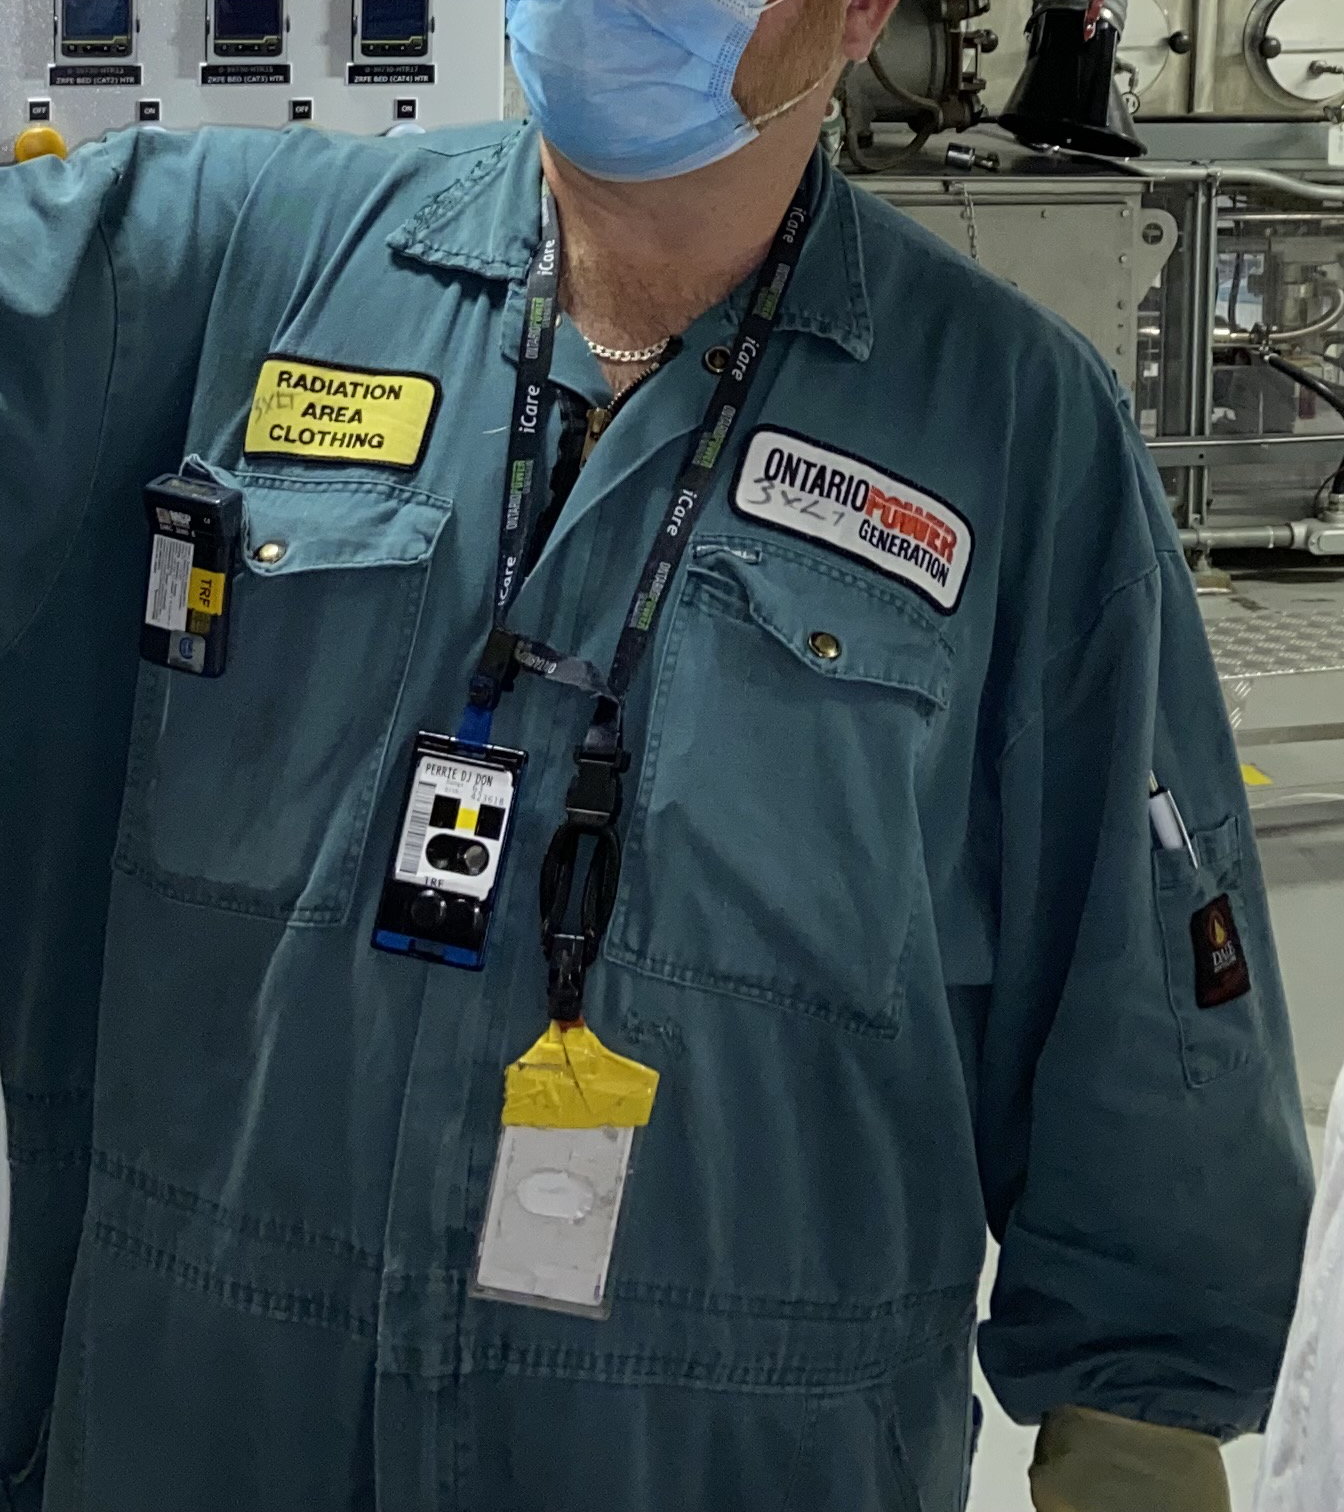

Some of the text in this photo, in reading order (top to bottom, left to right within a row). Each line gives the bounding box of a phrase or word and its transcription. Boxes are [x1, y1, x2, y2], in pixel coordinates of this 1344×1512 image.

[76, 76, 92, 84] BED
[120, 76, 135, 84] HTR
[226, 75, 242, 83] BED
[269, 75, 284, 83] HTR
[373, 75, 388, 83] BED
[32, 107, 46, 115] OFF
[783, 206, 805, 244] iCare
[537, 239, 556, 276] iCare
[732, 335, 756, 382] iCare
[277, 370, 403, 400] RADIATION
[301, 402, 363, 424] AREA
[519, 384, 540, 434] iCare
[269, 424, 385, 449] CLOTHING
[667, 488, 698, 537] iCare
[858, 518, 950, 588] GENERATION
[199, 578, 213, 607] TRF
[498, 556, 517, 606] iCare
[425, 762, 458, 780] PERRIE
[460, 769, 472, 783] DJ
[475, 773, 493, 787] DON
